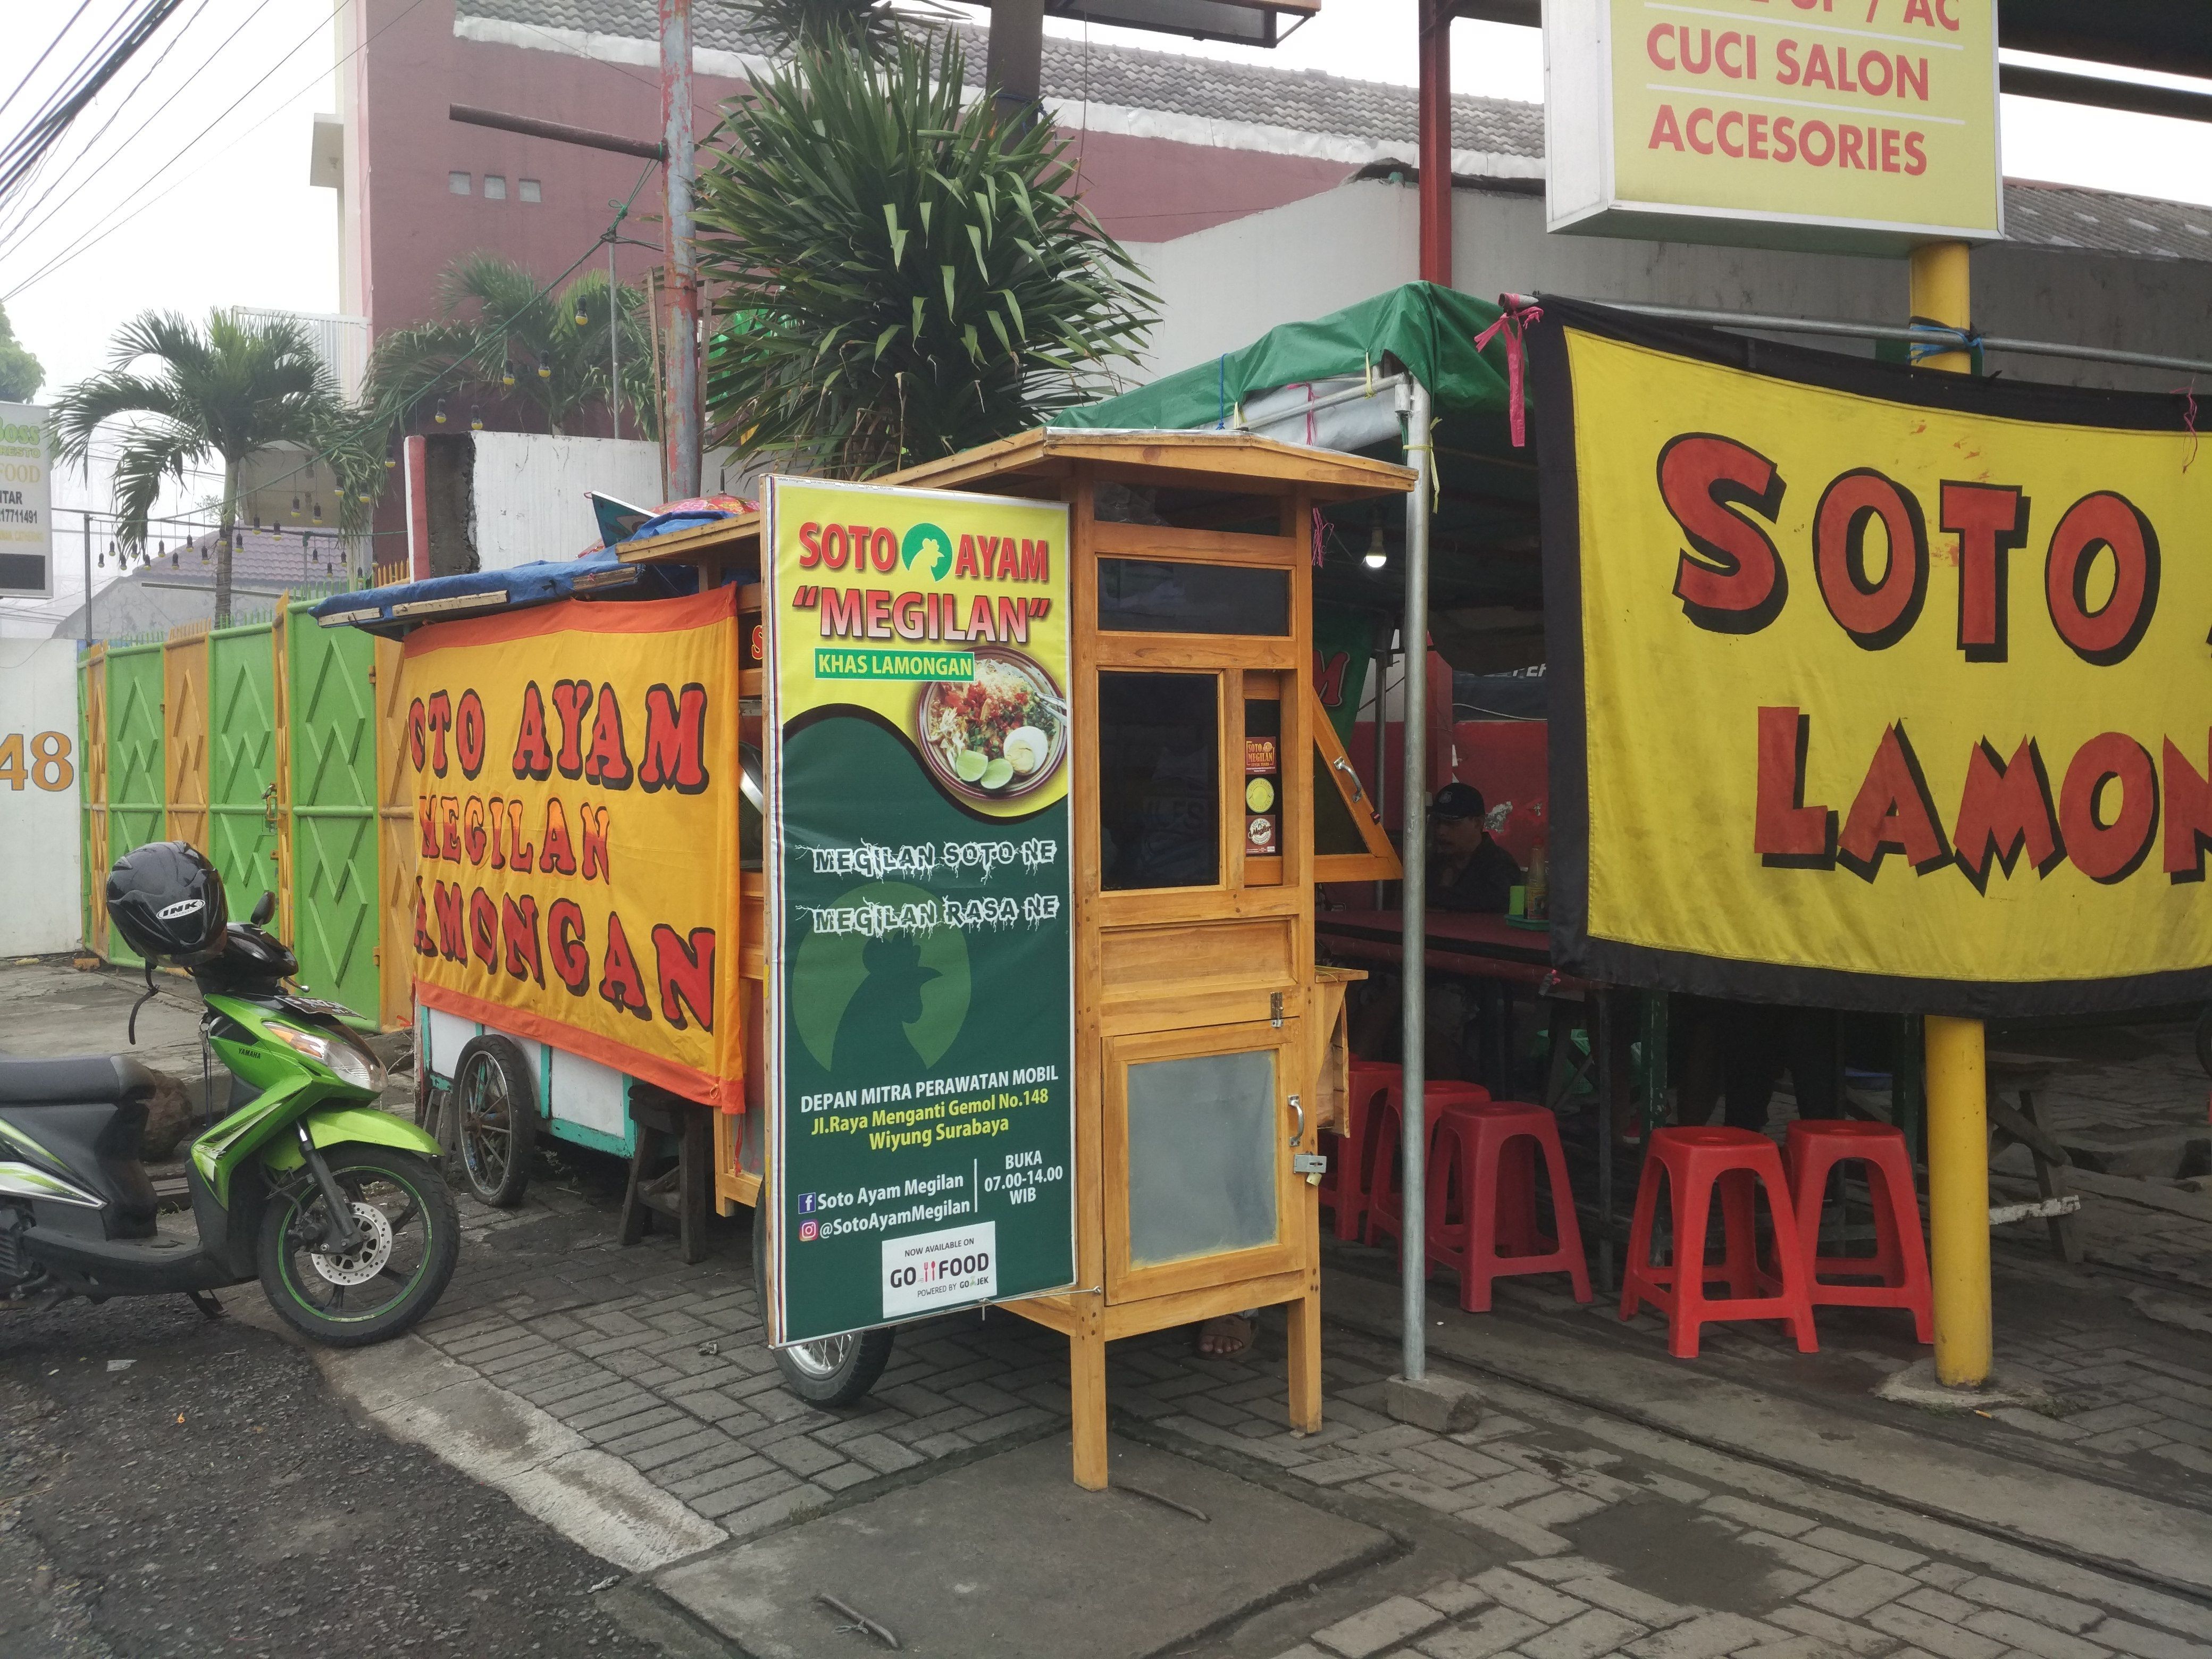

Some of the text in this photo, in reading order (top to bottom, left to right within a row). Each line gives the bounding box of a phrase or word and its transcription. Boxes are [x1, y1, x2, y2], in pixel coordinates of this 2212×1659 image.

[1646, 23, 1930, 102] CUCI SALON
[1647, 104, 1928, 176] ACCESORIES
[0, 490, 22, 505] TAR
[798, 522, 1049, 581] SOTO AYAM
[1656, 431, 2161, 666] SOTO
[819, 654, 972, 676] KHAS LAMONGAN
[512, 680, 708, 795] AYAM
[1248, 743, 1262, 752] SOTO
[1248, 752, 1272, 762] MEGILAN
[812, 839, 1057, 880] MEGILAN SOTO NE
[163, 901, 198, 917] INK
[812, 894, 1060, 939] MEGILAN RASA NE
[239, 1048, 261, 1059] YAMAHA
[801, 1065, 1058, 1112] DEPAN MITRA PERAWATAN MOBIL
[811, 1088, 1049, 1135] Jl.Raya Menganti Gemol No.148
[869, 1118, 1009, 1152] Wiyung Surabaya
[1006, 1150, 1043, 1169] BUKA
[818, 1192, 853, 1210] Soto
[857, 1185, 900, 1206] Ayam
[904, 1174, 963, 1196] Megilan
[984, 1166, 1063, 1192] 07.00-14.00
[1010, 1187, 1036, 1205] WIB
[819, 1199, 970, 1239] @SotoAyamMegilan
[904, 1237, 974, 1257] NOW AVAILABLE ON
[890, 1253, 989, 1288] GO FOOD
[917, 1276, 989, 1297] POWERED BY GO JEK
